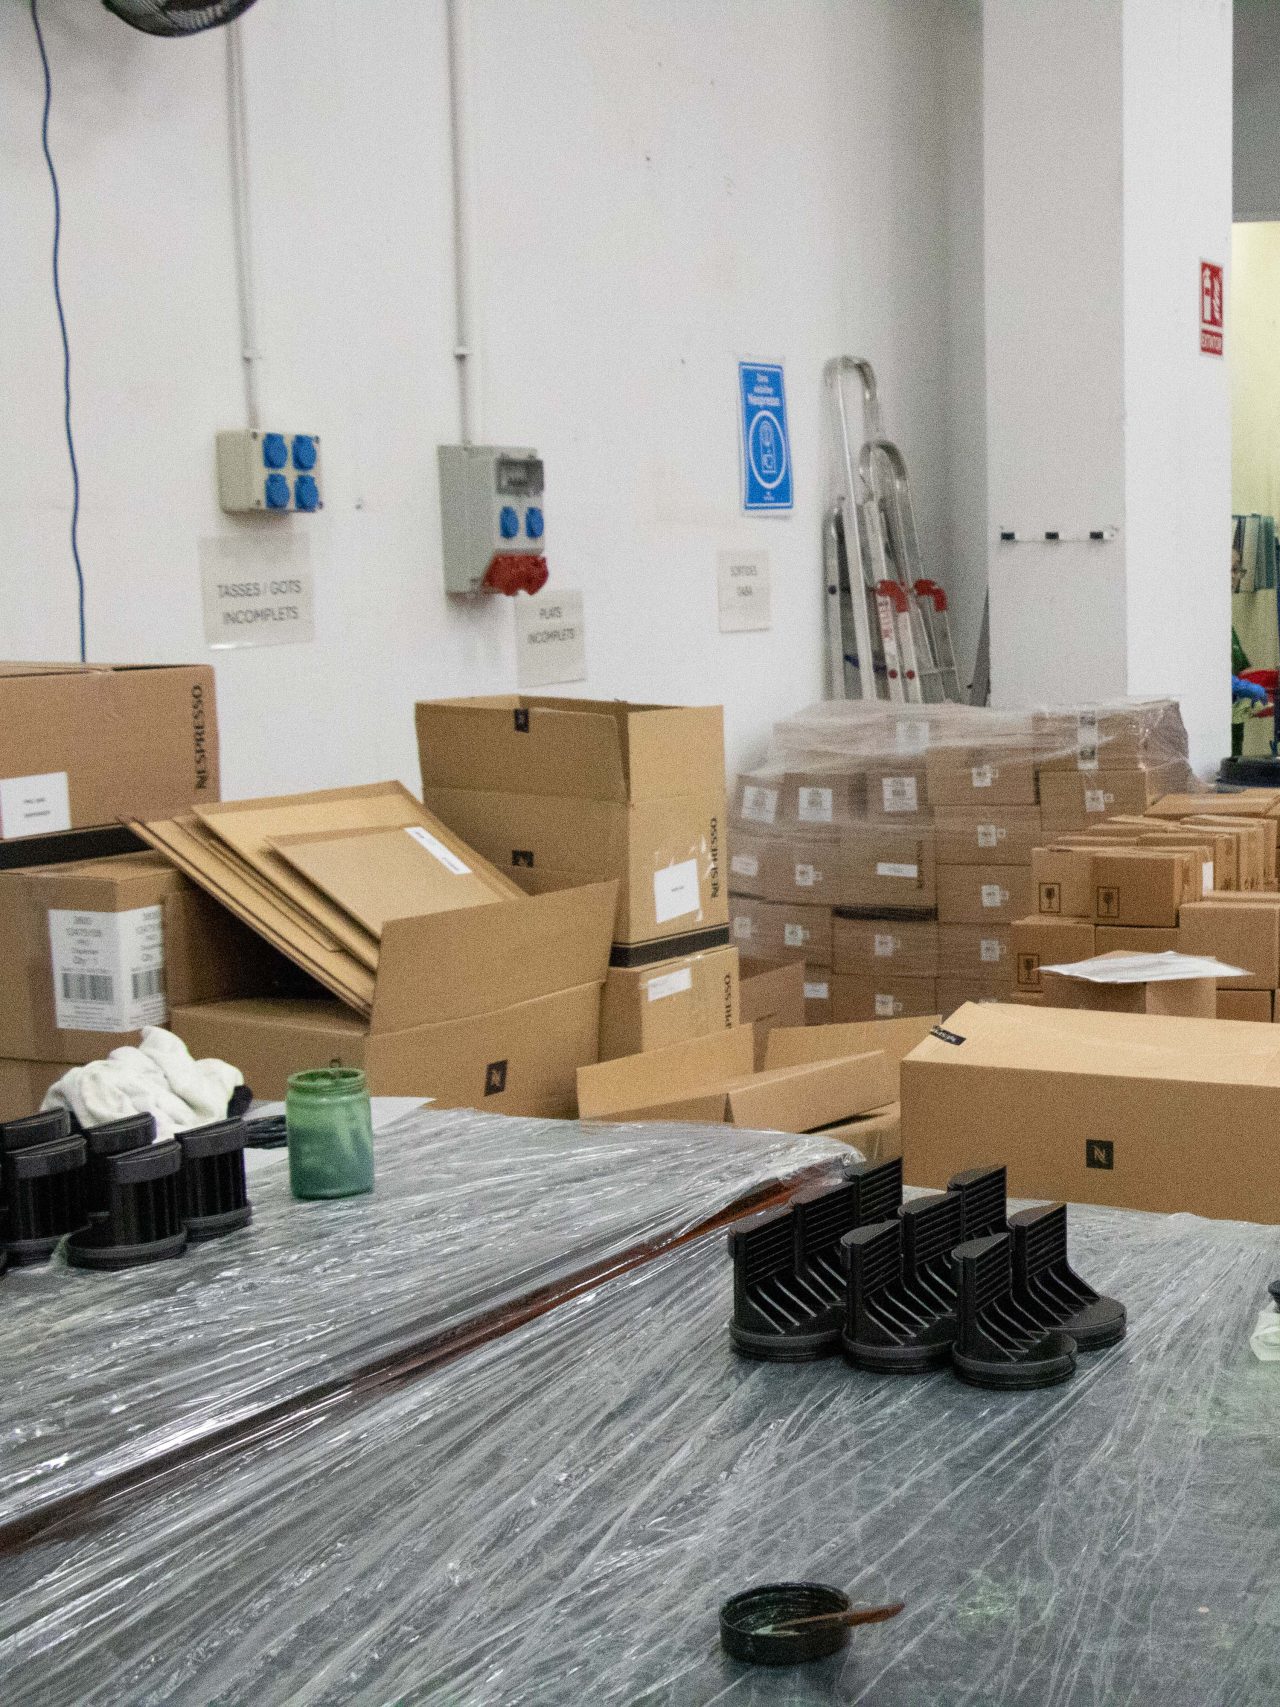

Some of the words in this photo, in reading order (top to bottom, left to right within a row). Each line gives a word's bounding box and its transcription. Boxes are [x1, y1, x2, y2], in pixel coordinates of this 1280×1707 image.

[217, 582, 261, 600] TASSES
[270, 579, 302, 595] GOTS
[222, 605, 299, 625] INCOMPLETS
[191, 684, 207, 789] NESPRESSO
[724, 973, 732, 1029] PRESSO
